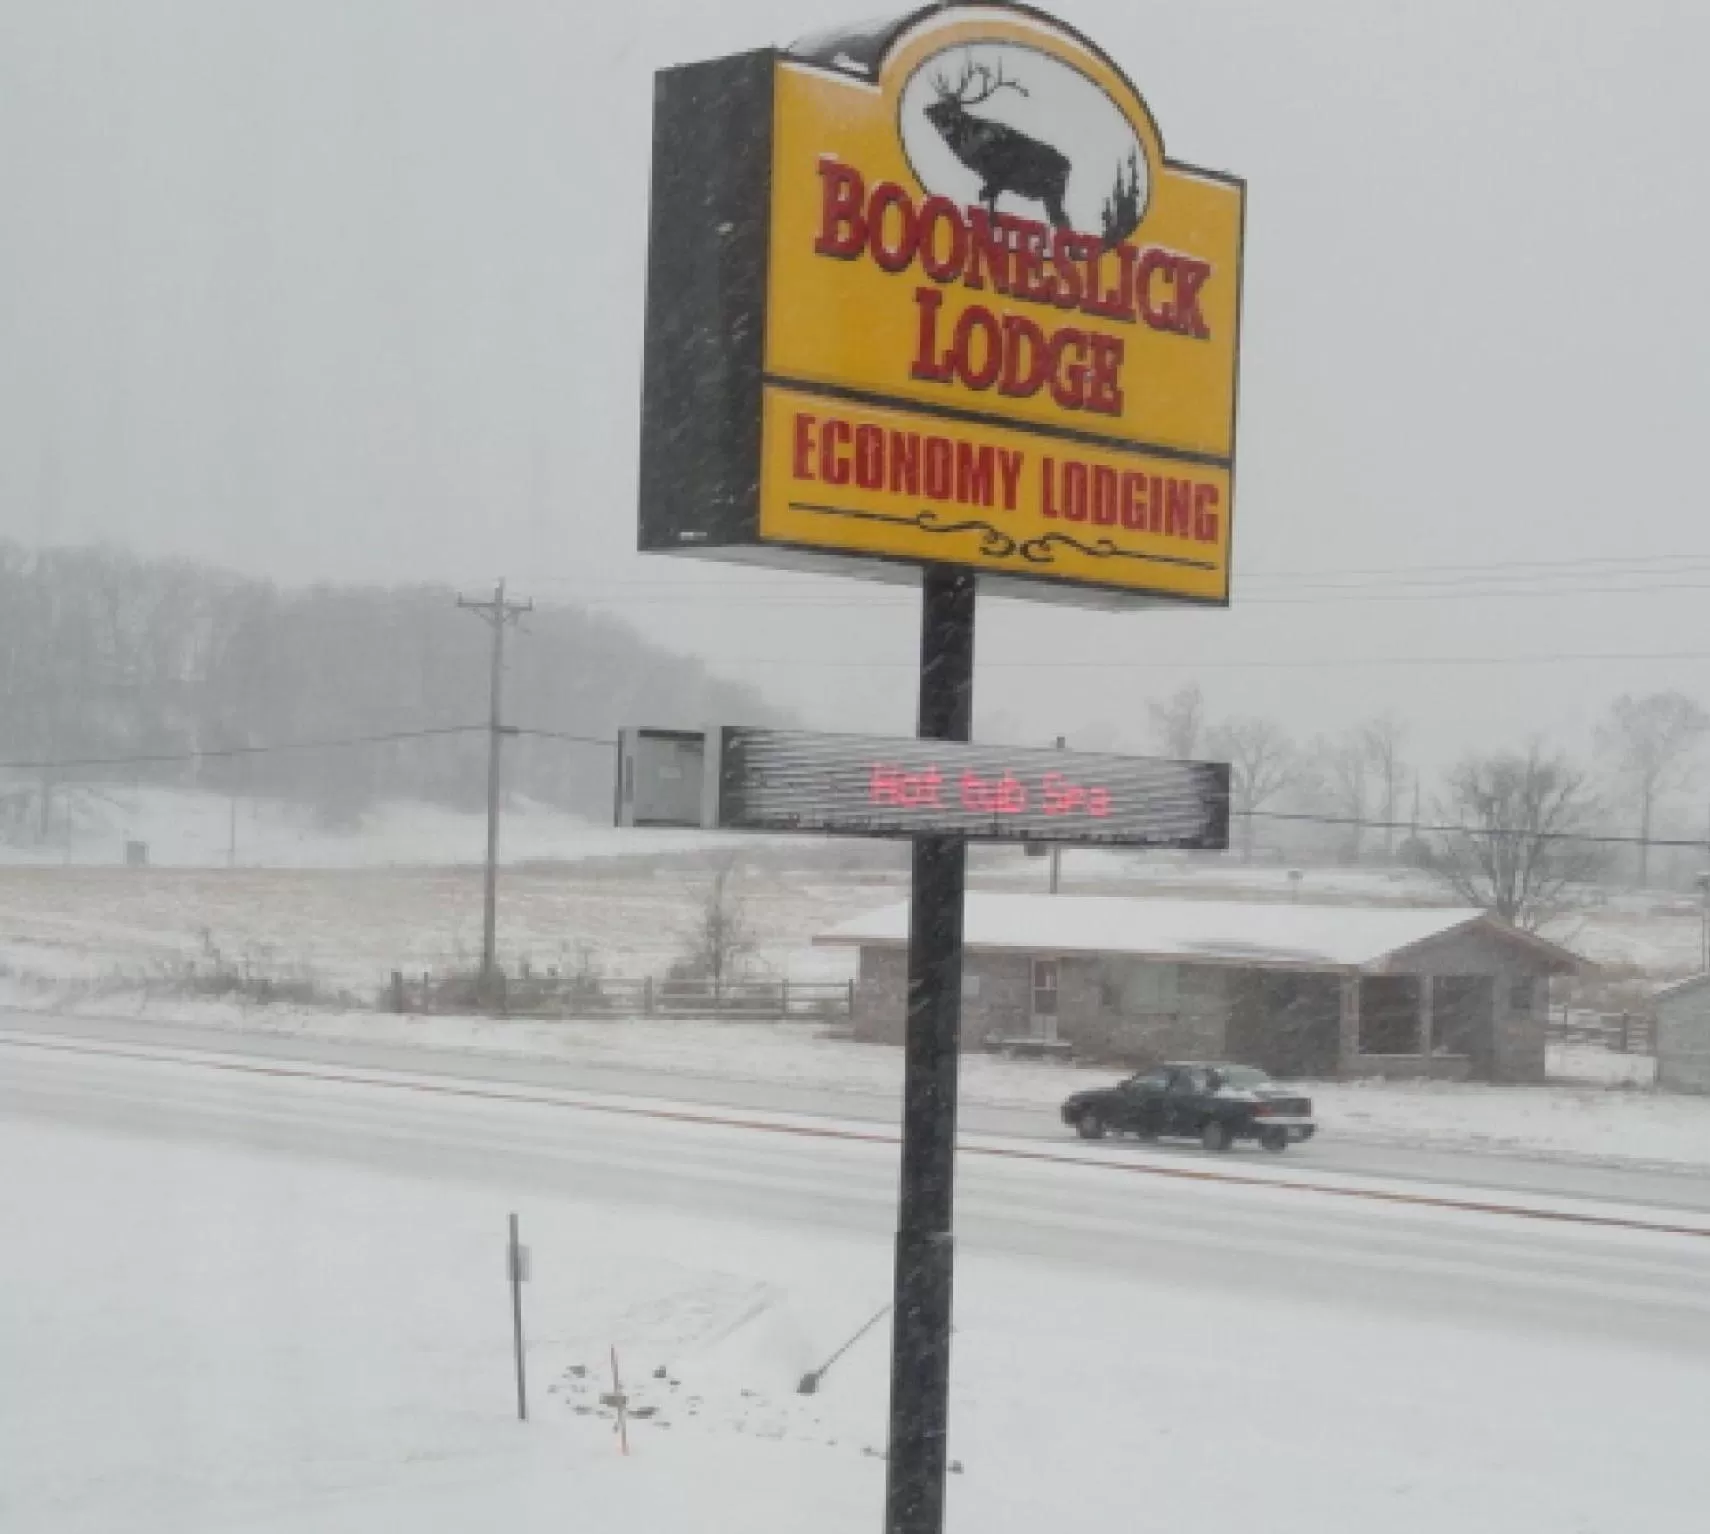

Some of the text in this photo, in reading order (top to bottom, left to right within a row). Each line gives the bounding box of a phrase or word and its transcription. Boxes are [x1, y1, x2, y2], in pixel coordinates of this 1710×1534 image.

[814, 154, 1212, 339] BOONESLICK
[910, 287, 1124, 416] LODGE
[792, 412, 1220, 544] ECONOMY LODGING
